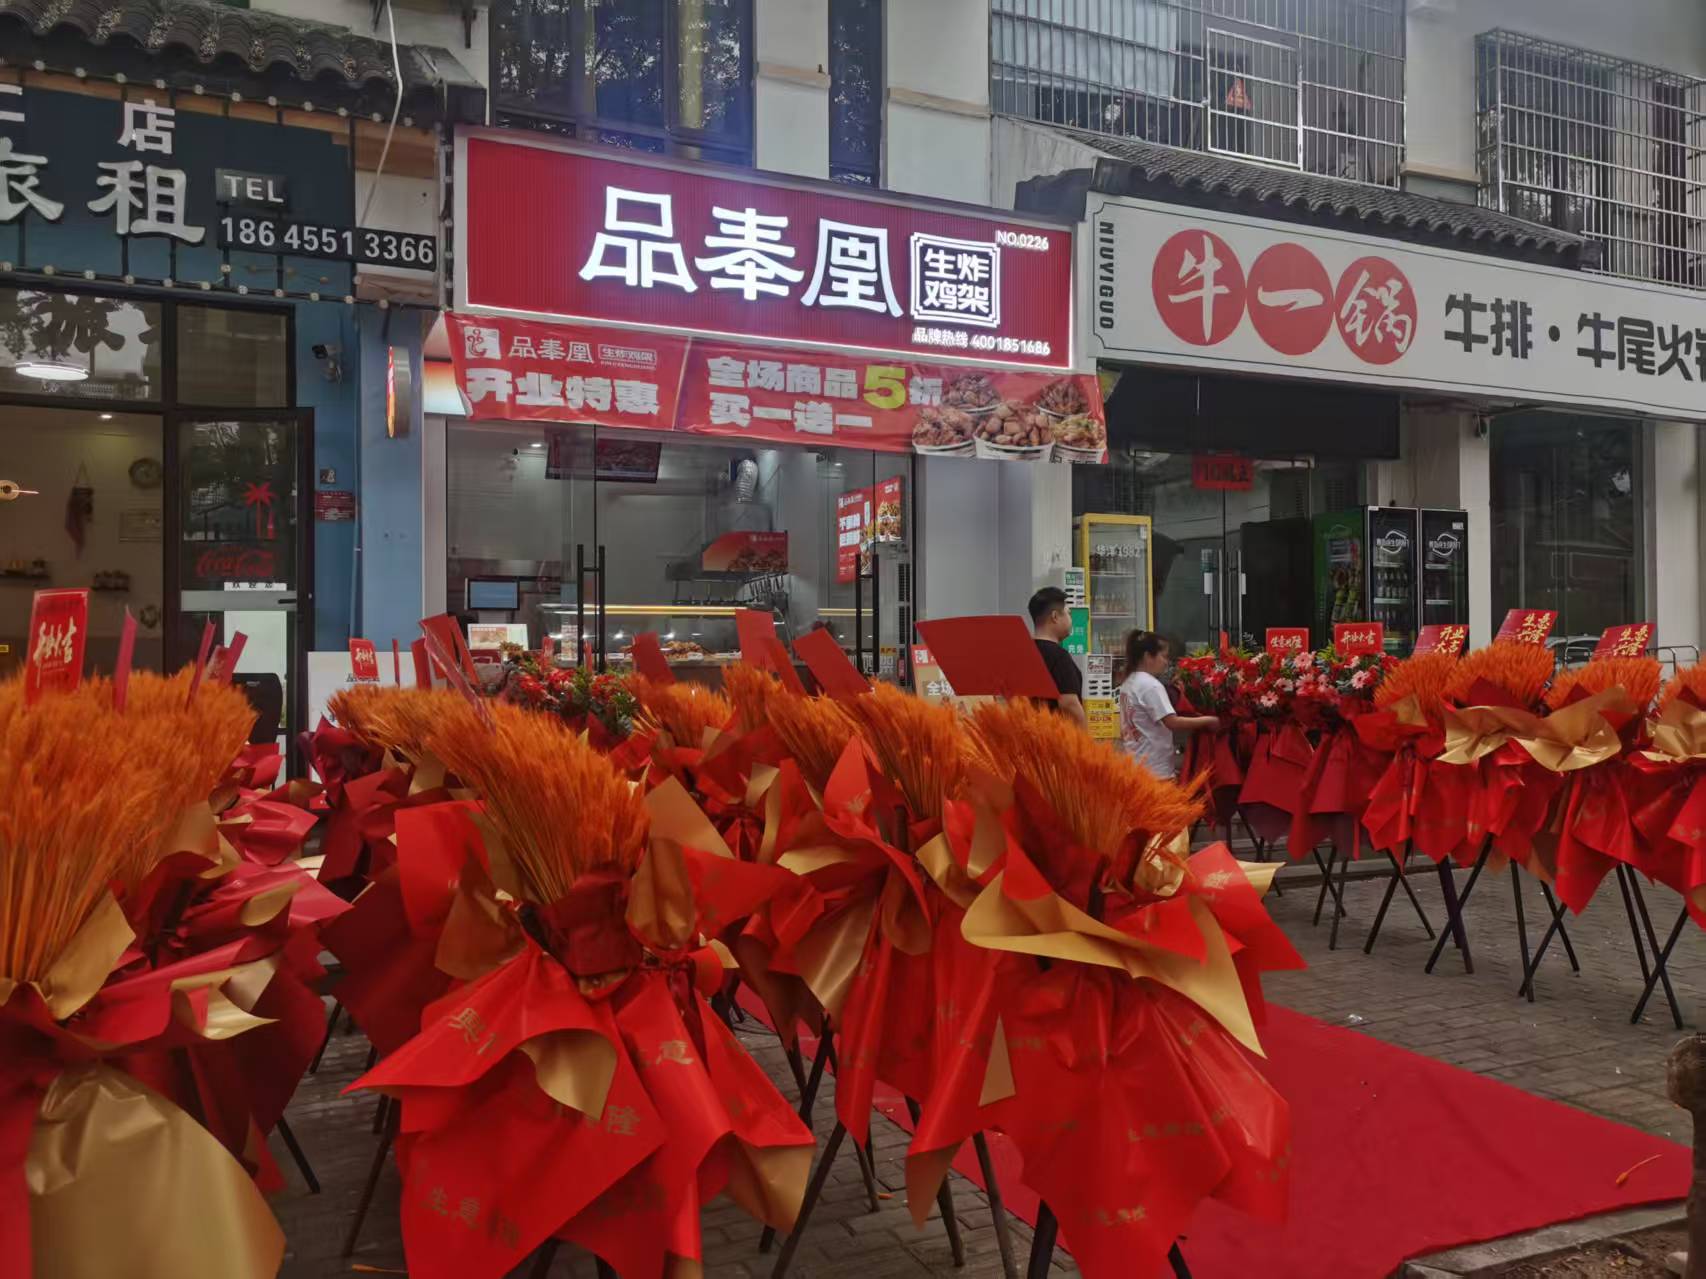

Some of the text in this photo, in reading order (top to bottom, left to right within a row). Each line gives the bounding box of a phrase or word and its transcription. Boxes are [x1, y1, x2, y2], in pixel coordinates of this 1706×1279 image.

[118, 99, 176, 154] 店
[223, 175, 284, 203] TEL
[221, 216, 434, 264] 186 4551 3366
[578, 184, 905, 318] 品奉凰
[996, 230, 1050, 252] NO.0226
[923, 248, 990, 283] 生炸
[1099, 221, 1115, 330] NIUYIGUO
[923, 279, 990, 314] 鸡架
[1167, 233, 1414, 354] 牛一锅
[912, 327, 1050, 355] 品牌热线 4001851686
[1443, 292, 1706, 383] 牛排·牛尾火
[465, 367, 660, 416] 开业特惠
[709, 391, 873, 434] 买一送一
[1439, 625, 1465, 641] 开业
[1522, 612, 1551, 630] 生意
[1620, 624, 1648, 643] 生意
[1434, 640, 1460, 654] 大吉
